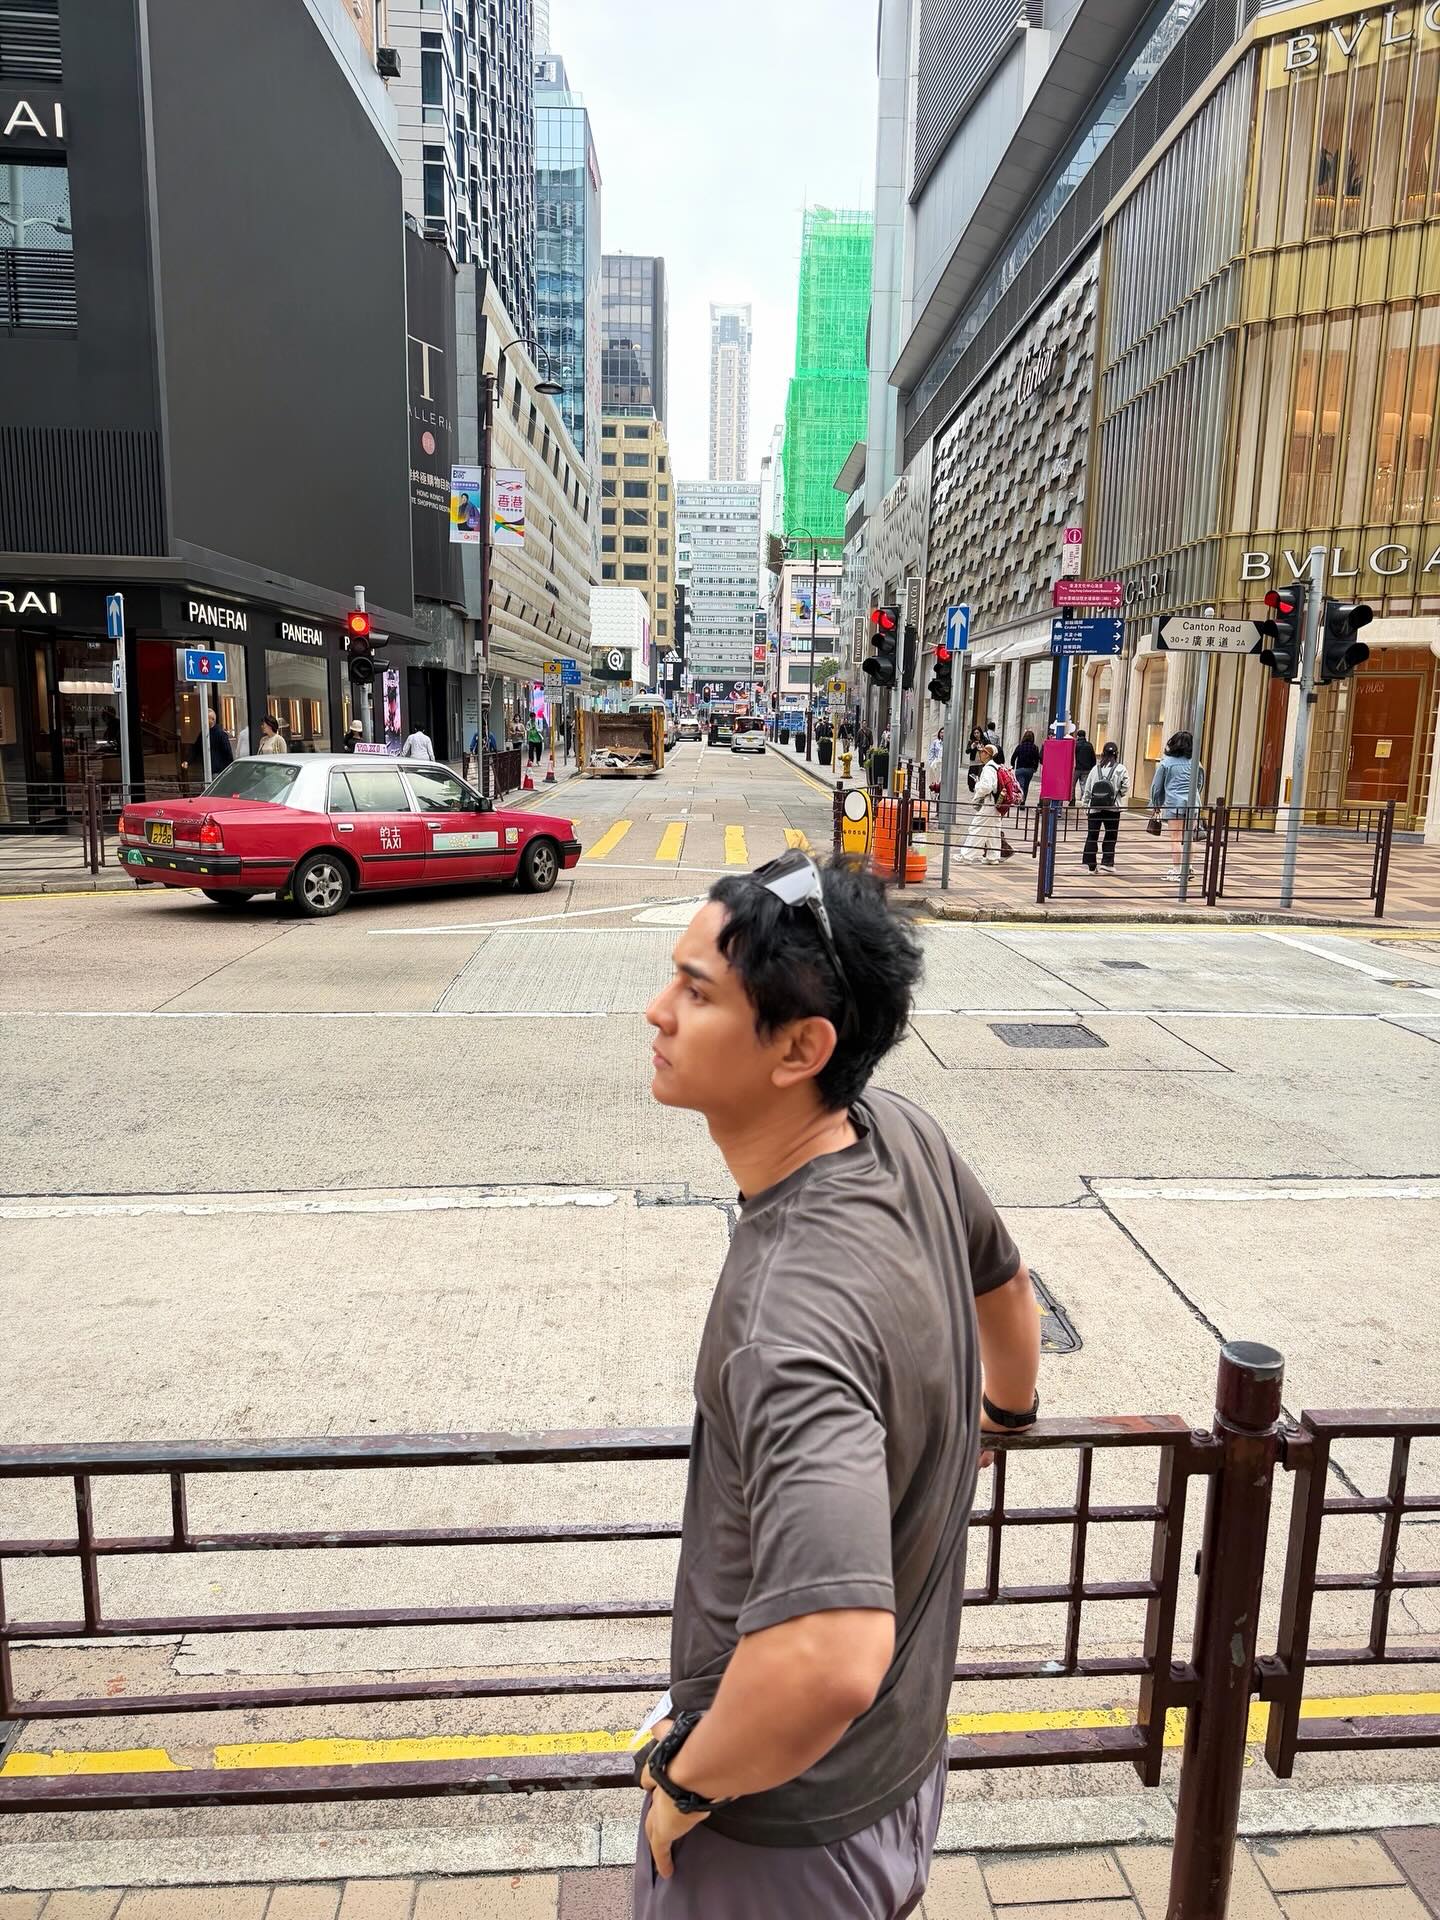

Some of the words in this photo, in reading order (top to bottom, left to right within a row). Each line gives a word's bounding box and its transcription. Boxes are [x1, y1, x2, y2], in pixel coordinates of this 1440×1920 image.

[498, 494, 523, 509] 香港
[189, 601, 248, 631] PANERAI
[1183, 621, 1215, 632] Canton
[1219, 623, 1242, 633] Road
[282, 622, 323, 646] PANERAI
[1192, 635, 1228, 648] 廣東道
[357, 744, 381, 752] TAXI
[380, 826, 400, 838] 的士
[153, 833, 171, 844] 2728
[380, 838, 402, 849] TAXI
